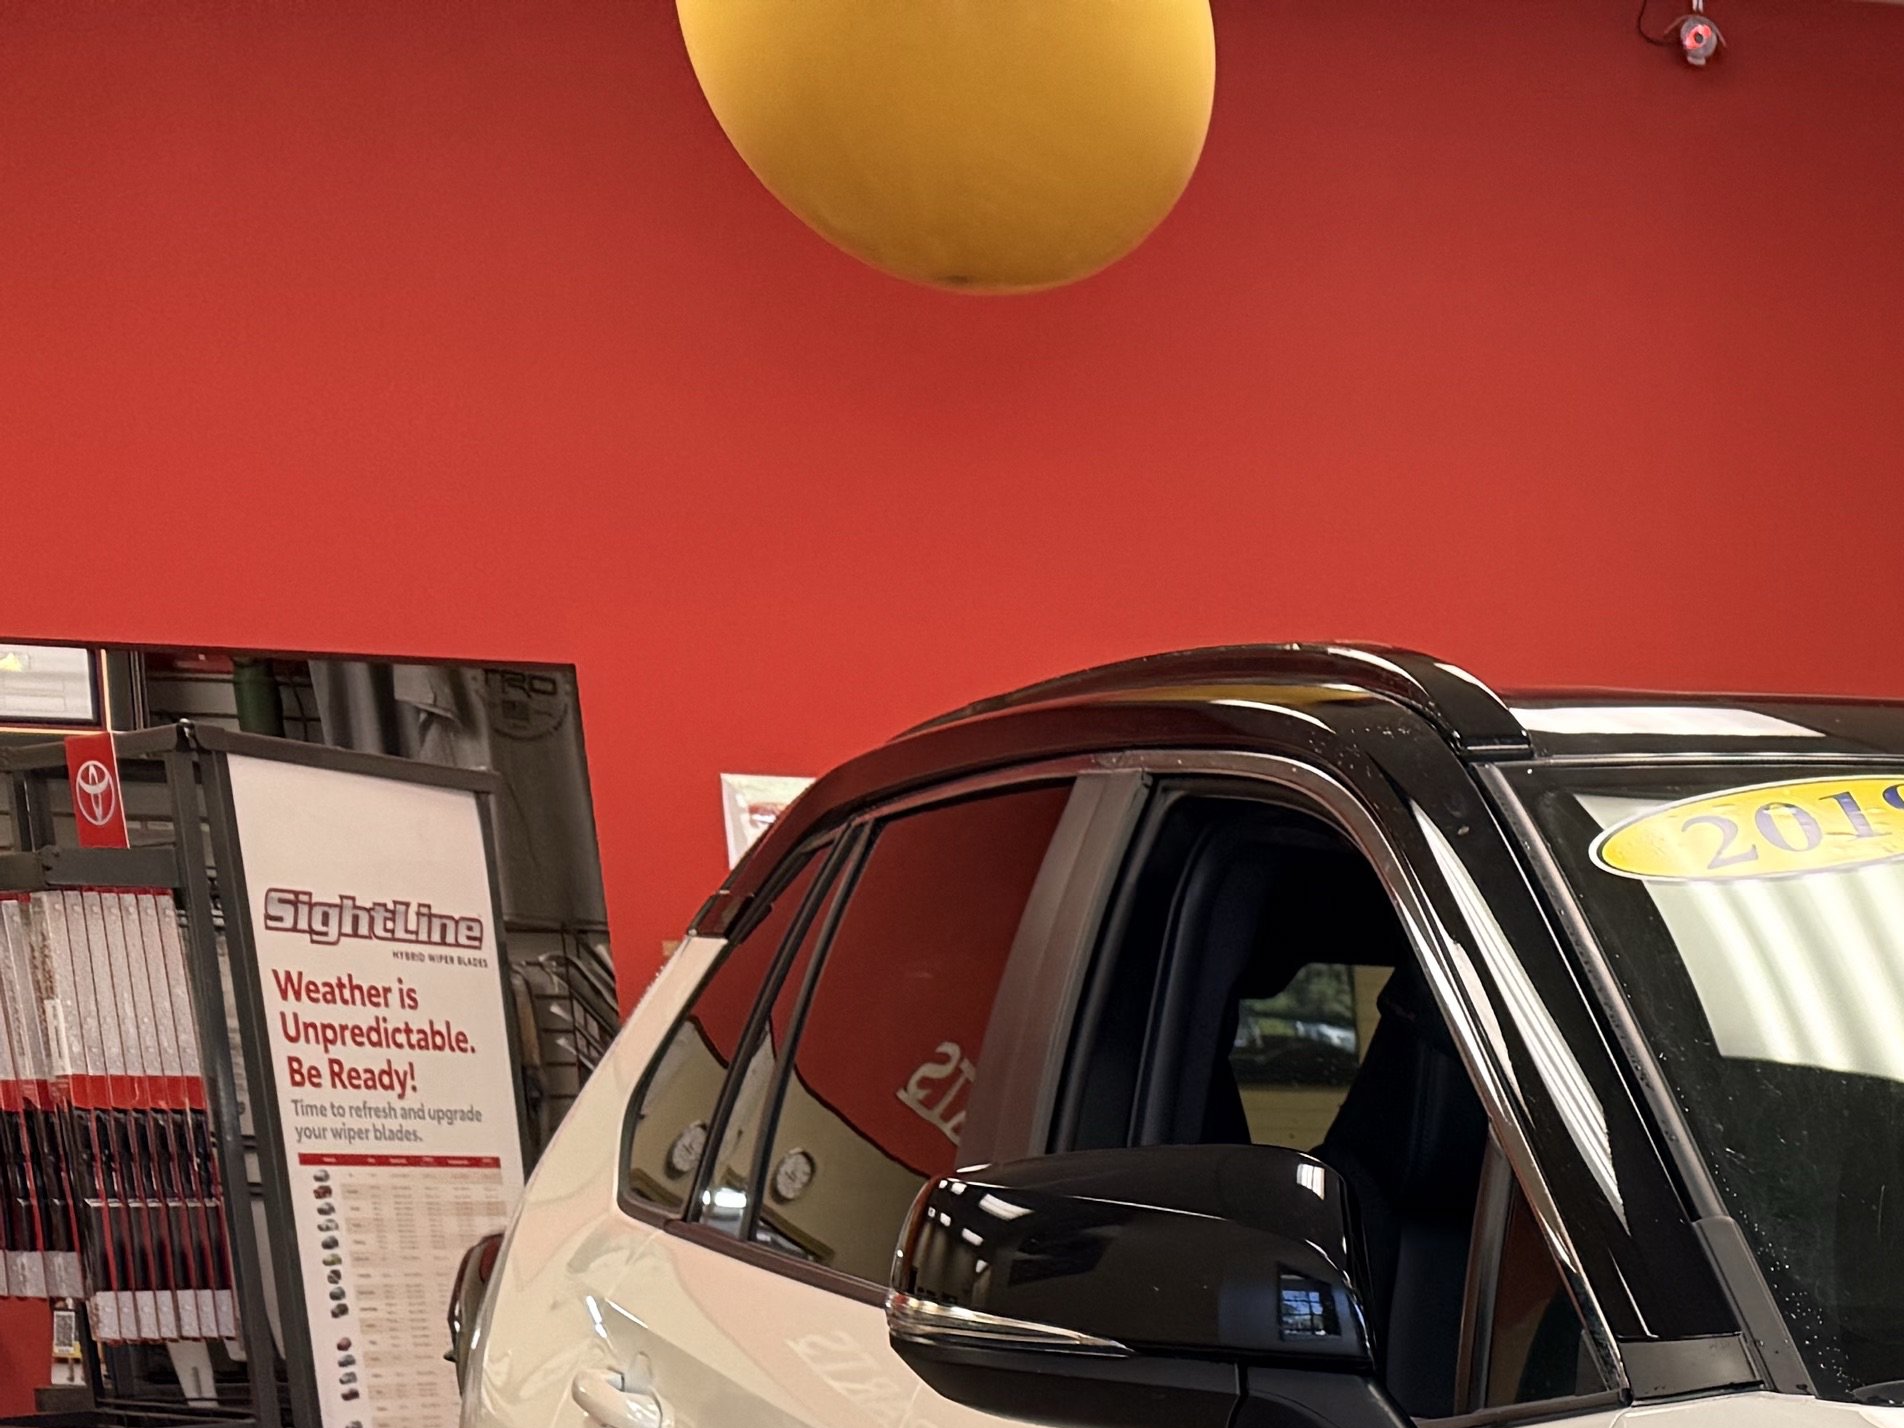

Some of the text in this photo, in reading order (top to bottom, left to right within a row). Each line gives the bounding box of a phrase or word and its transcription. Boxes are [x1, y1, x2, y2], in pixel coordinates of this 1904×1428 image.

[264, 887, 483, 950] SightLine
[392, 951, 488, 969] HYBRID WIPER BLADES
[272, 968, 419, 1011] Weather is
[279, 1011, 476, 1054] Unpredictable.
[287, 1056, 418, 1100] Be Ready!
[291, 1099, 482, 1125] Time to refresh and upgrade
[296, 1124, 423, 1145] your wiper blades.
